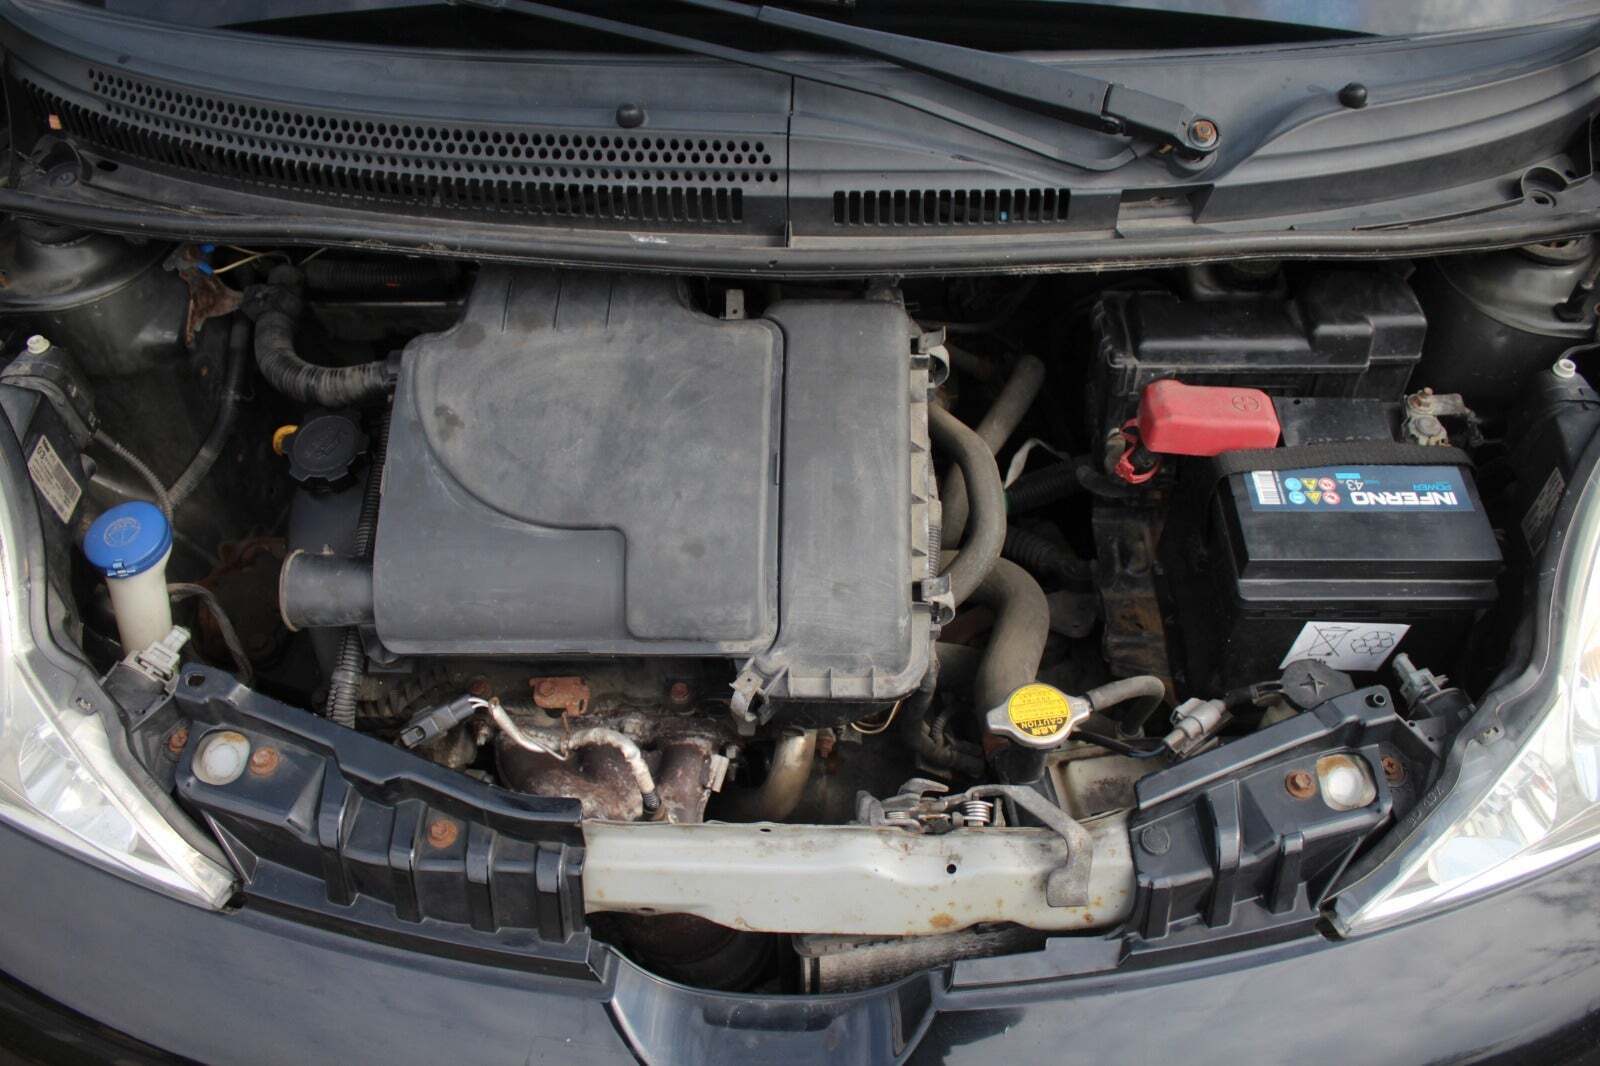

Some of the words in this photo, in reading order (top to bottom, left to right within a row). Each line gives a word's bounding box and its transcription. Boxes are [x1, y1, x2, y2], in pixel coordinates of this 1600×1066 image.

[1346, 479, 1364, 491] 43
[1413, 481, 1452, 491] POWER
[1350, 491, 1458, 505] INFERNO
[1021, 717, 1063, 729] CAUTION
